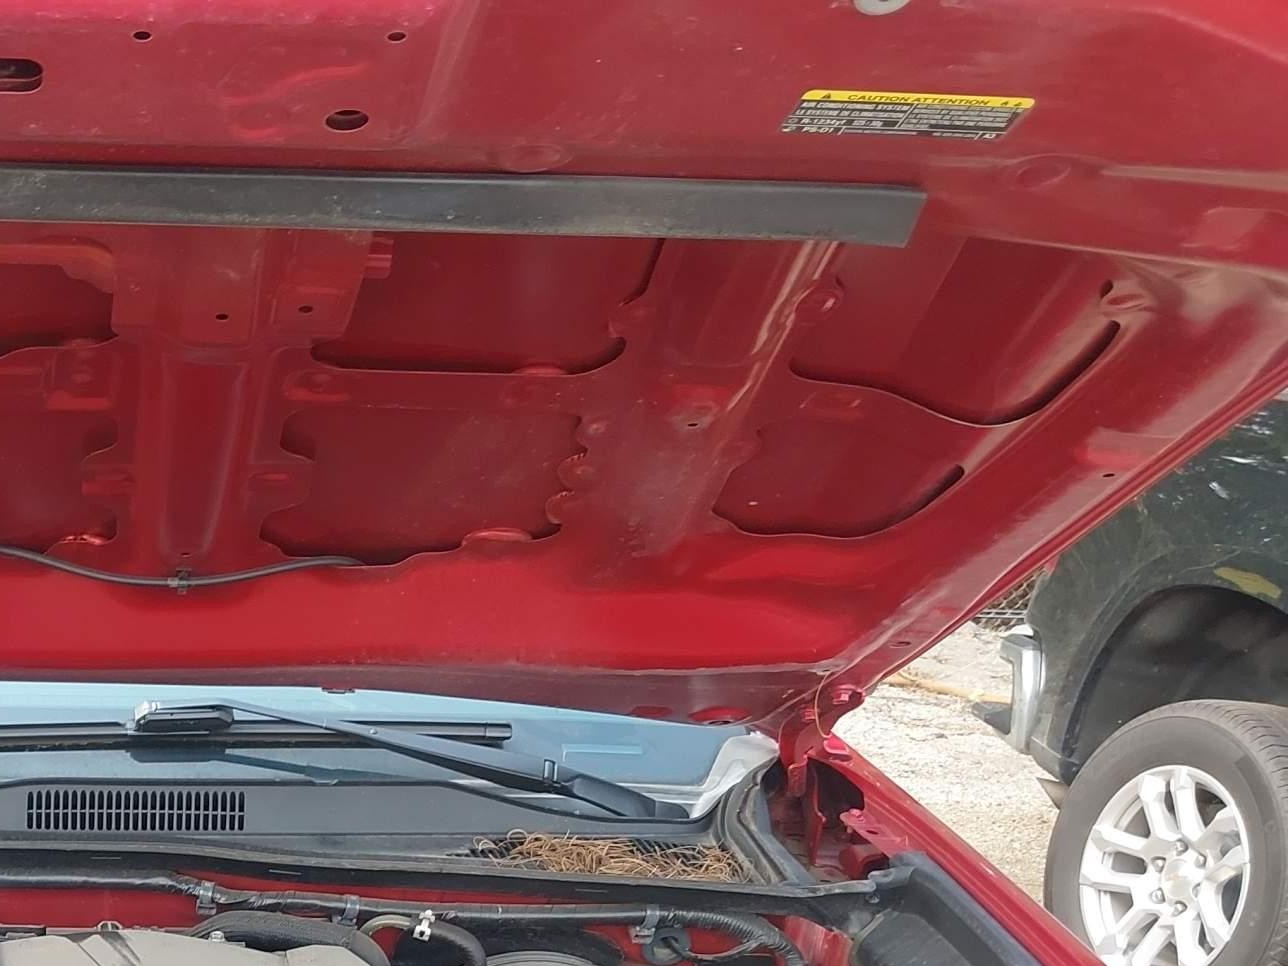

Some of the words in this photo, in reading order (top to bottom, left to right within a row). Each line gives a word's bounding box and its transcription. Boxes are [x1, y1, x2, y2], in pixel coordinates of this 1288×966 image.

[847, 94, 910, 102] CAUTION
[913, 97, 990, 105] ATTENTION
[875, 103, 911, 111] SYSTEM
